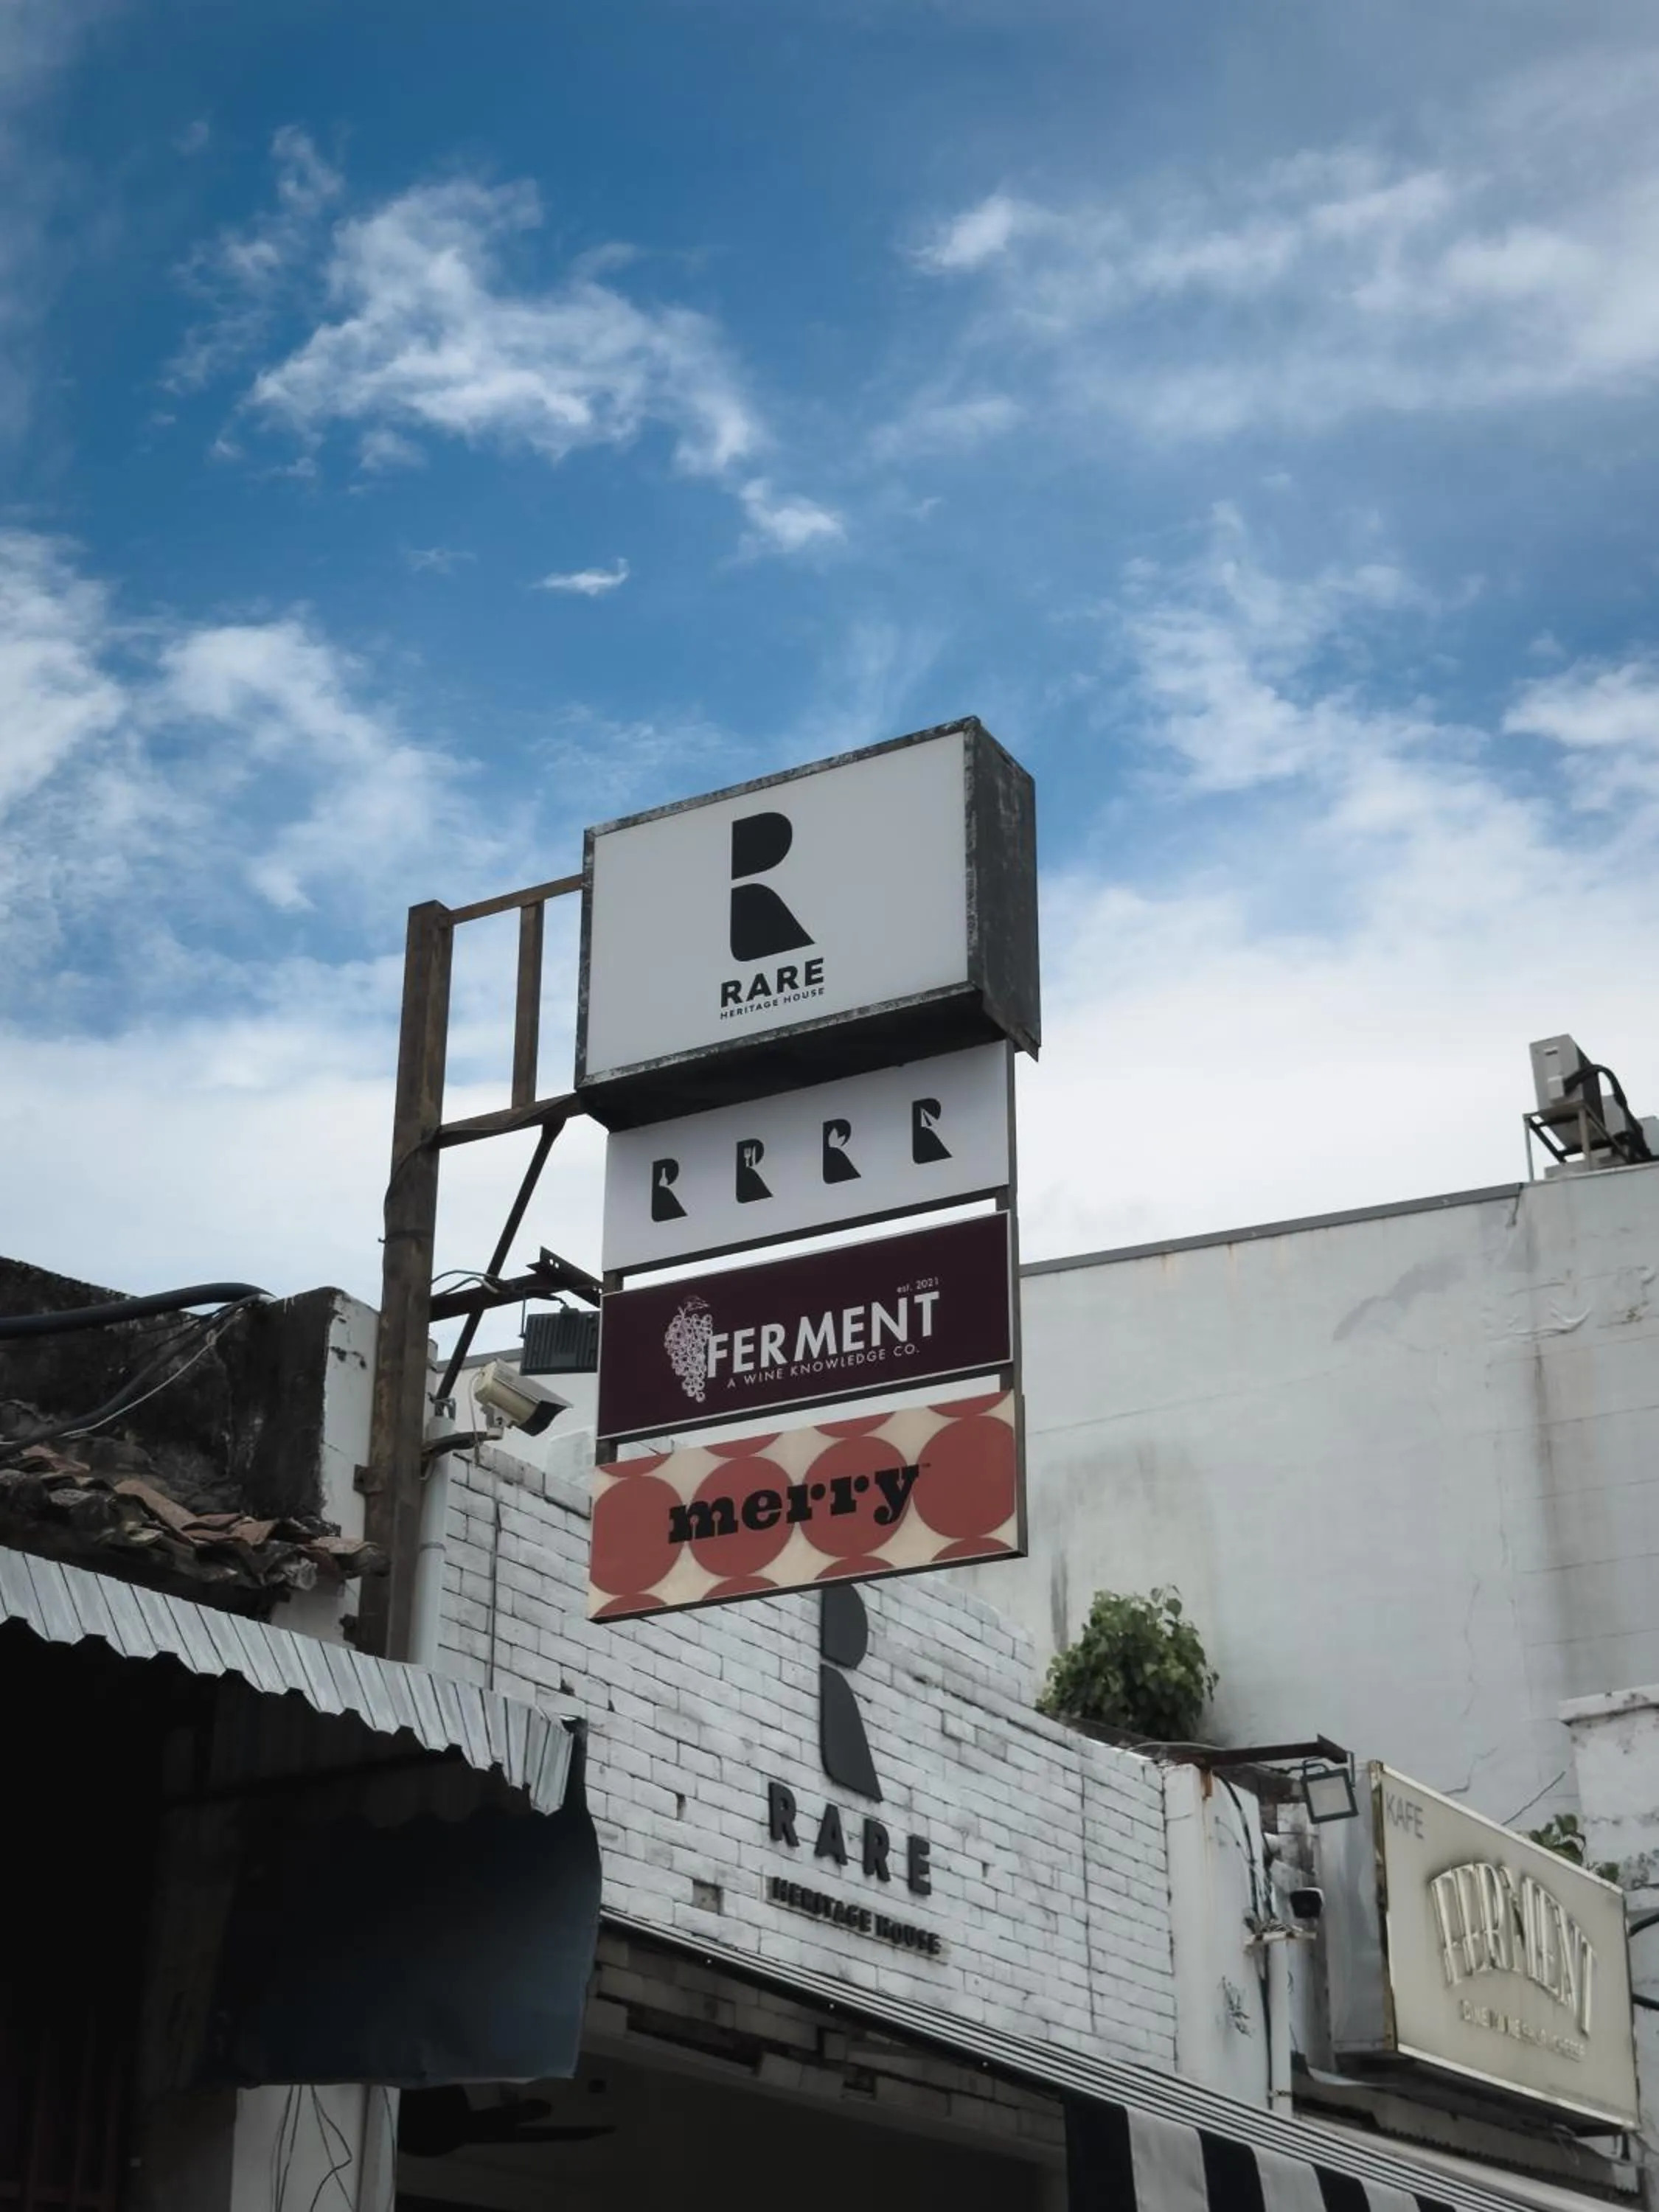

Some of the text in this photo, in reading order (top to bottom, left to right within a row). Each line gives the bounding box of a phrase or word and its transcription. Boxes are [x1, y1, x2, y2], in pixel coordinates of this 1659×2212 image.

[720, 957, 824, 1007] RARE
[720, 987, 825, 1020] HERITAGE HOUSE
[916, 1276, 939, 1290] 2021
[706, 1291, 940, 1378] FERMENT
[727, 1343, 919, 1389] A WINE KNOWLEDGE CO.
[668, 1464, 920, 1544] merry
[768, 1781, 933, 1896] RARE
[1386, 1791, 1425, 1840] KAFE
[769, 1877, 942, 1955] HERITAGE HOUSE
